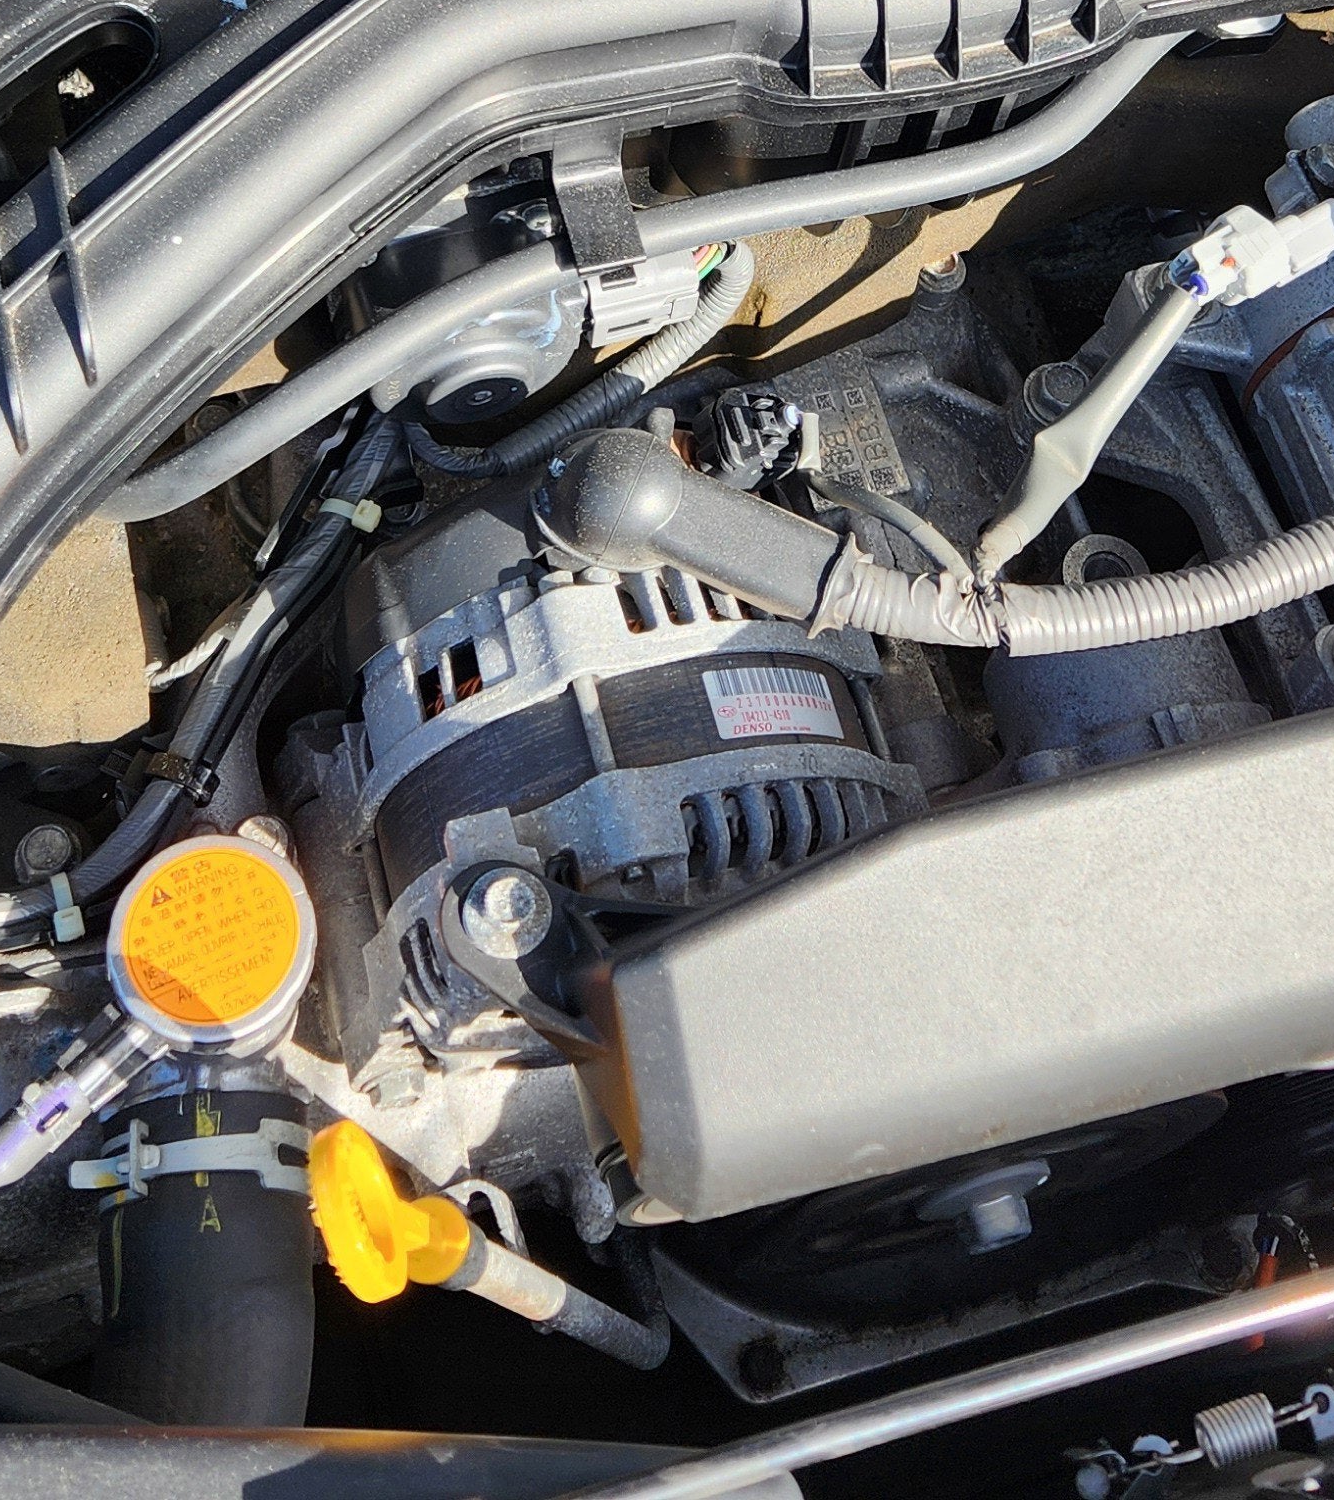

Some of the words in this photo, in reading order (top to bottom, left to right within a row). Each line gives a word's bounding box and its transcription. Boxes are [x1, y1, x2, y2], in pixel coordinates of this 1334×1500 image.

[734, 722, 773, 735] DENSO
[173, 861, 239, 897] WARNING
[180, 922, 214, 947] OPEN
[215, 905, 252, 931] WHEN
[254, 895, 279, 913] HOT
[174, 948, 276, 1003] AVERTISSEMENT
[199, 1194, 221, 1233] A
